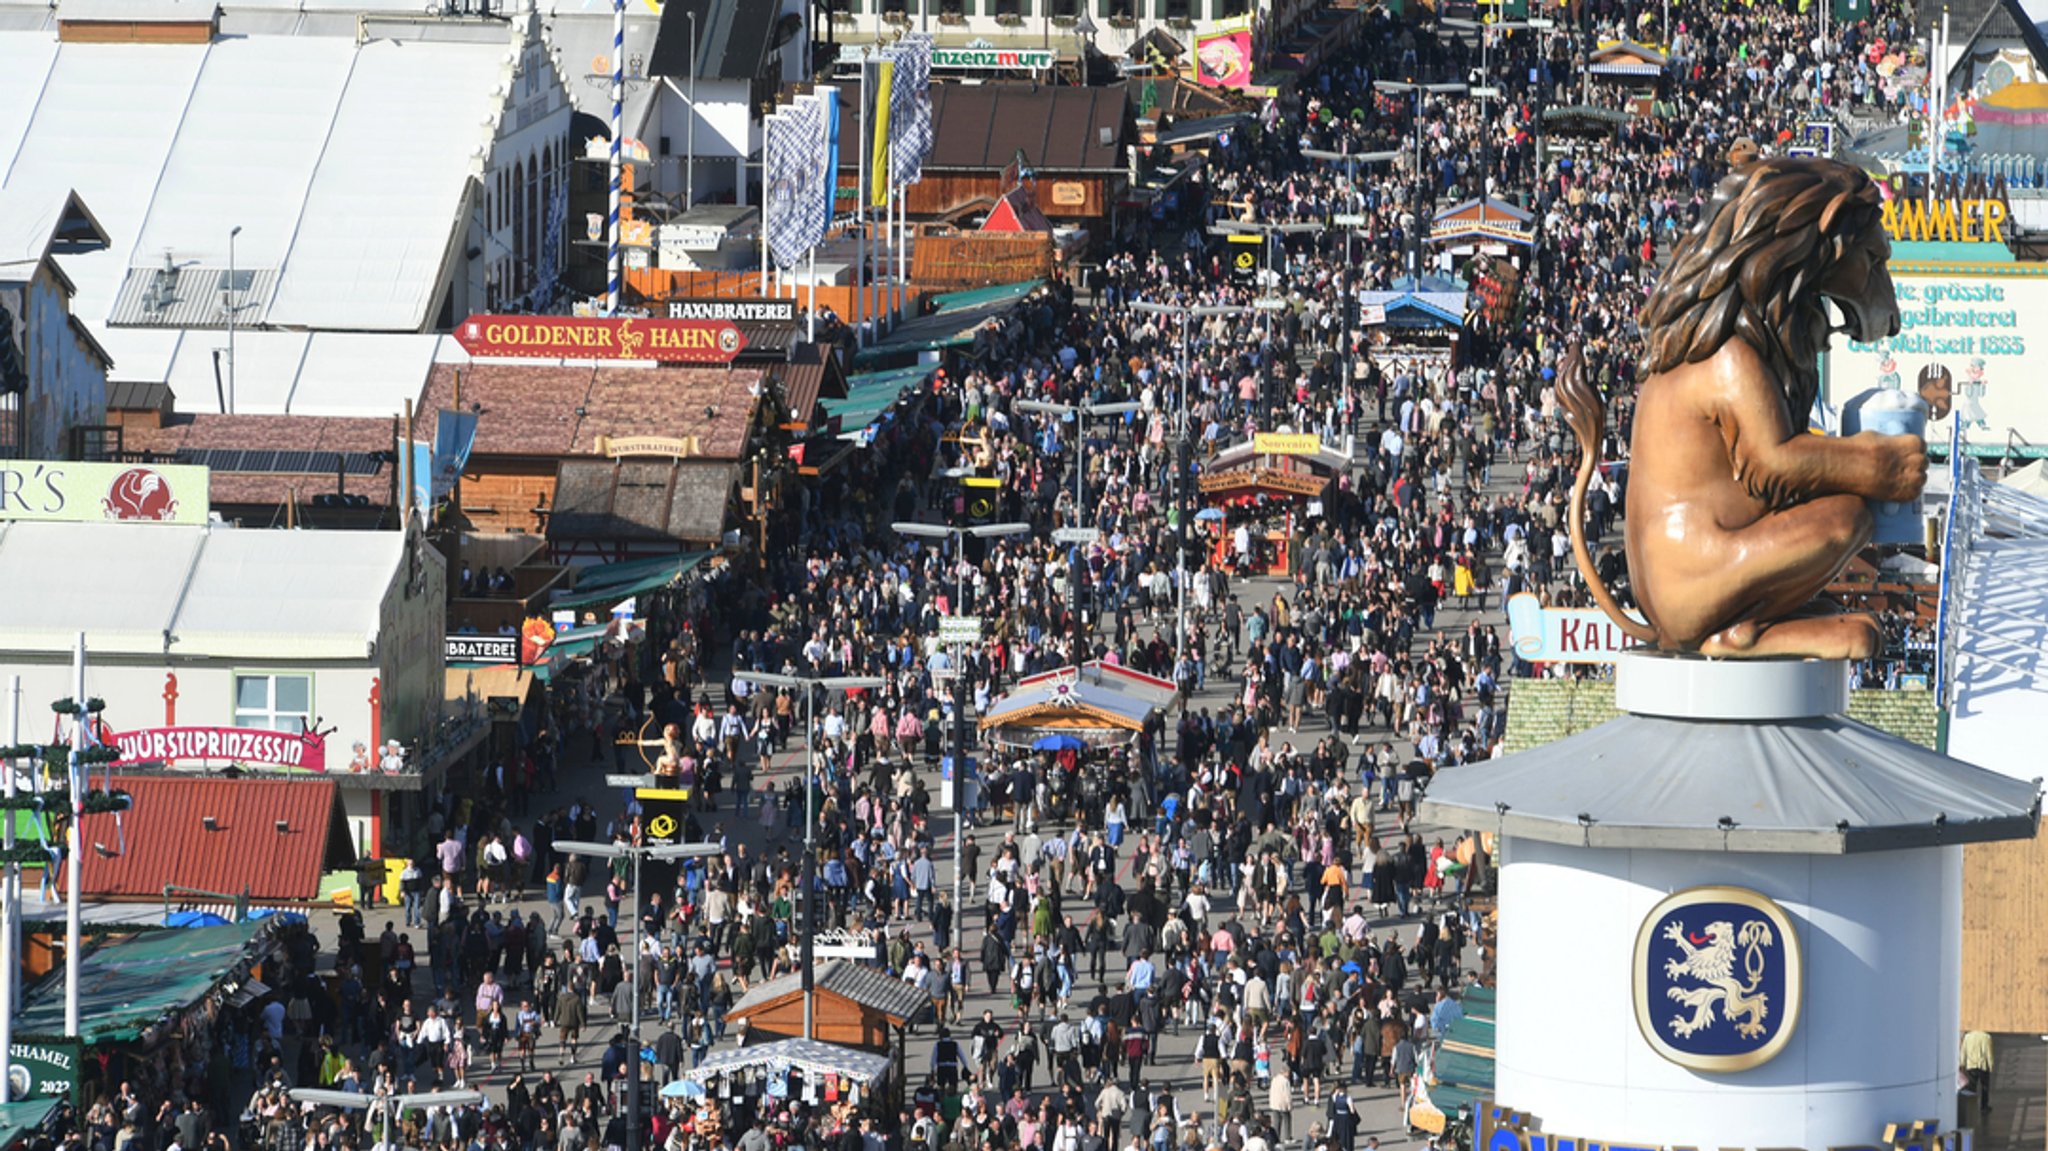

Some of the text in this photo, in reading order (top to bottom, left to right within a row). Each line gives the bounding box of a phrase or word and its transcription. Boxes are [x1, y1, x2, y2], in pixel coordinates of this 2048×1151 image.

[1880, 199, 2007, 243] AMMER
[1923, 281, 2005, 305] grösste
[669, 302, 792, 320] HAXNBRATEREI
[485, 323, 717, 349] GOLDENER HAHN
[1934, 336, 1975, 355] seit
[1980, 336, 2026, 355] 1885
[1261, 438, 1313, 449] Souvenirs
[117, 731, 303, 765] WÜRSTLPRINZESSIN
[40, 1080, 71, 1094] 2022
